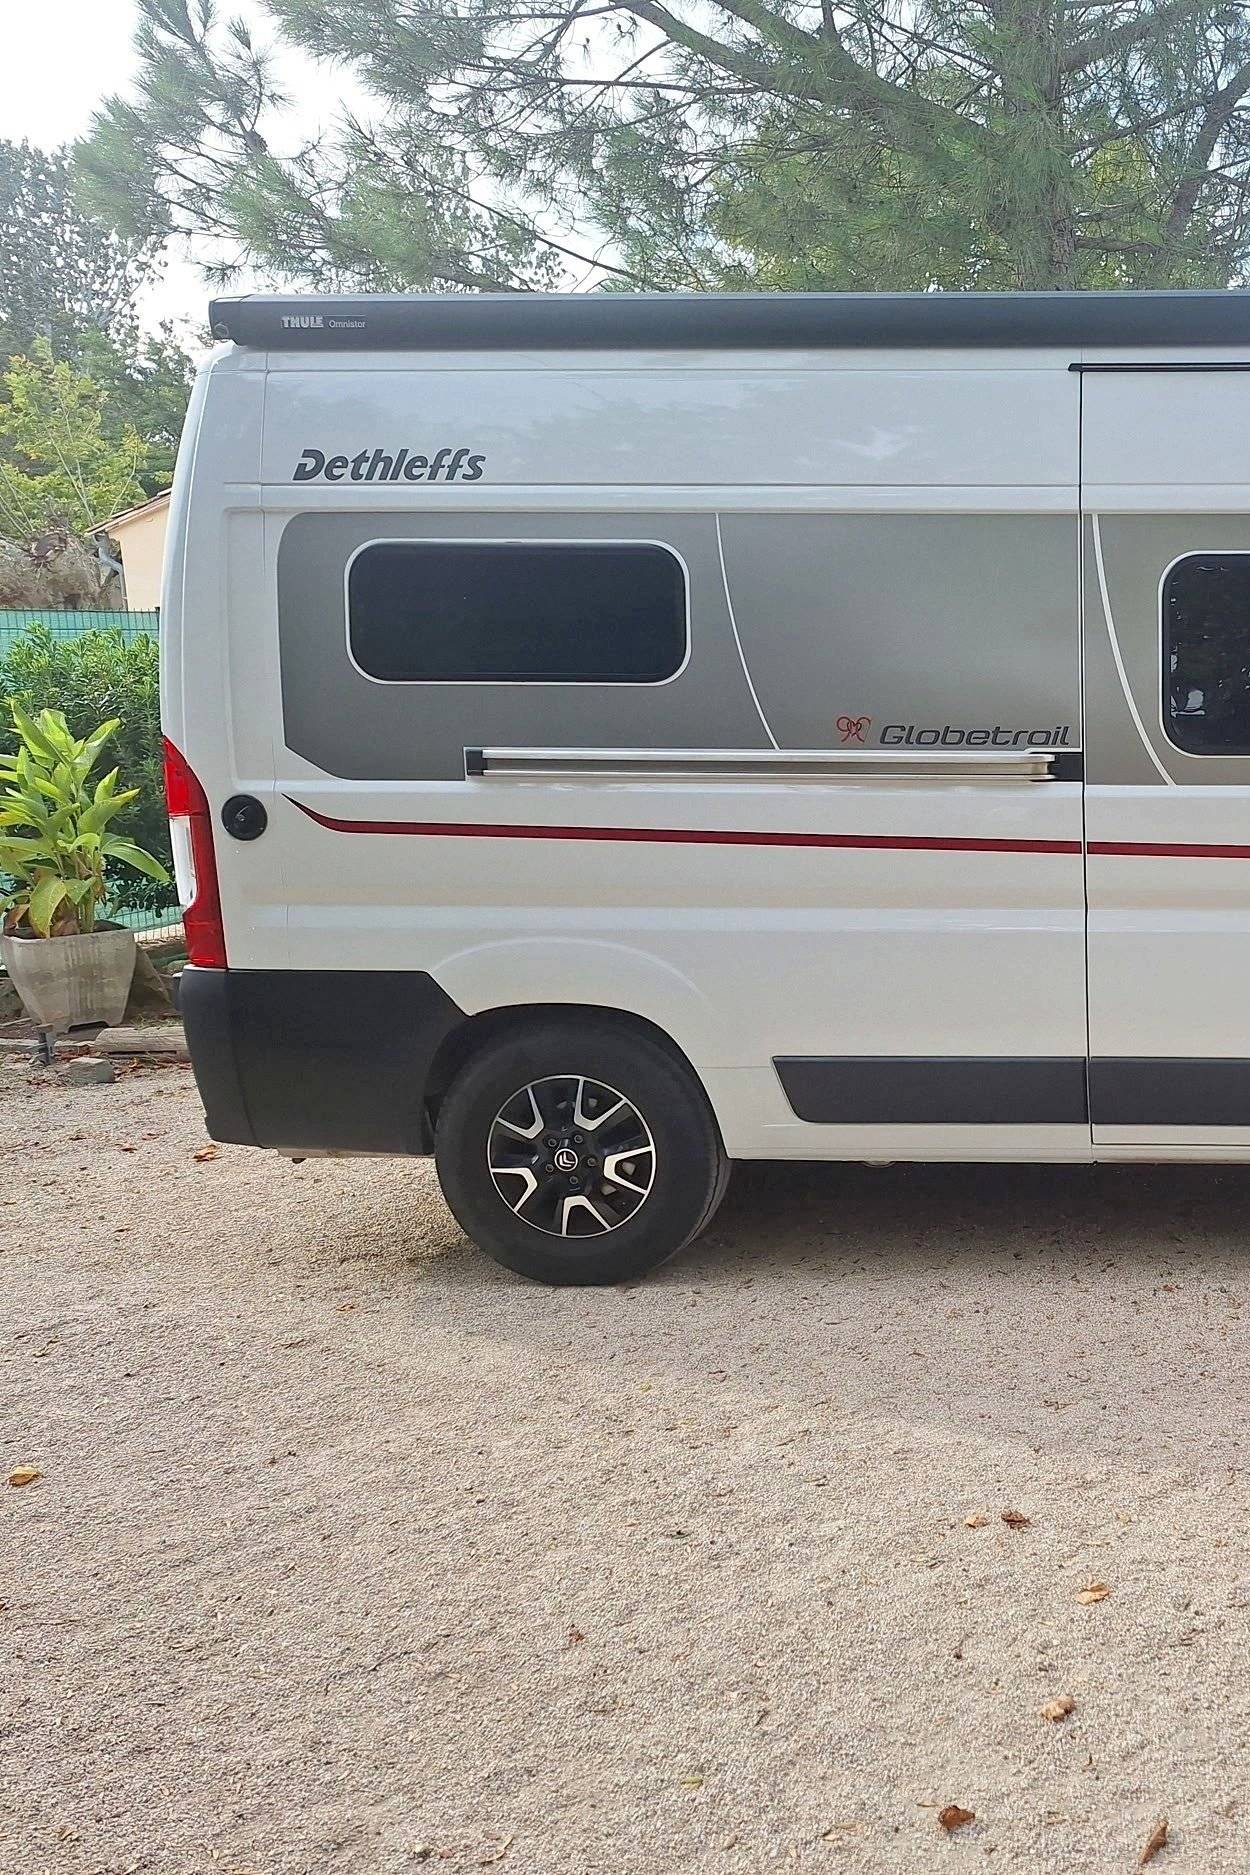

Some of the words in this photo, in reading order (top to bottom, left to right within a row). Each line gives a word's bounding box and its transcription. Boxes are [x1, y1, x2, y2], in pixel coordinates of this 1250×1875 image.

[281, 315, 324, 328] THULE
[328, 319, 366, 329] Omnistor
[292, 448, 487, 481] Dethleffs
[879, 725, 1070, 746] Globetrail
